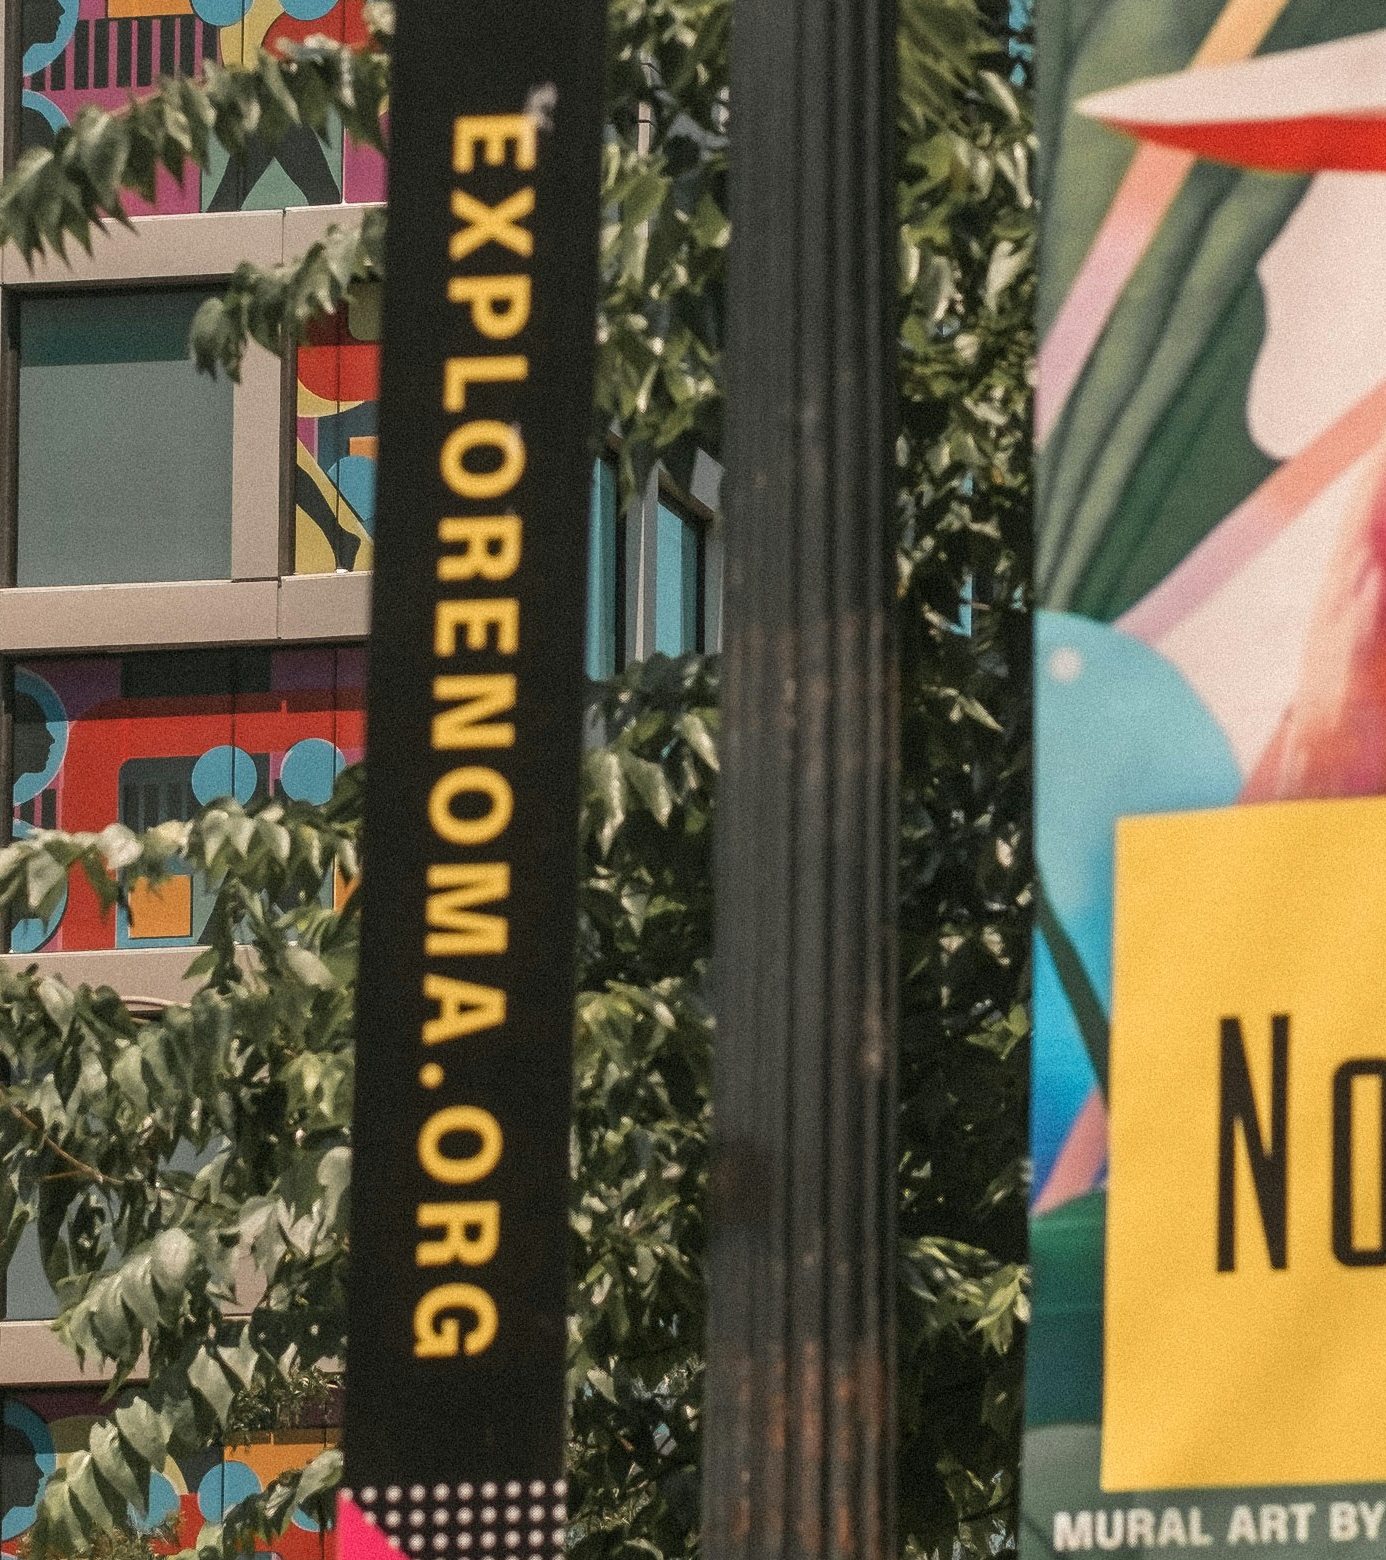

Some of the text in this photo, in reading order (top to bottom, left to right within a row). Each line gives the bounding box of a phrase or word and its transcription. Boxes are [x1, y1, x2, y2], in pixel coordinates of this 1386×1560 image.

[412, 113, 537, 1359] EXPLORENOMA.ORG
[1054, 1508, 1213, 1551] MURAL
[1227, 1503, 1315, 1544] ART
[1329, 1501, 1386, 1541] BY
